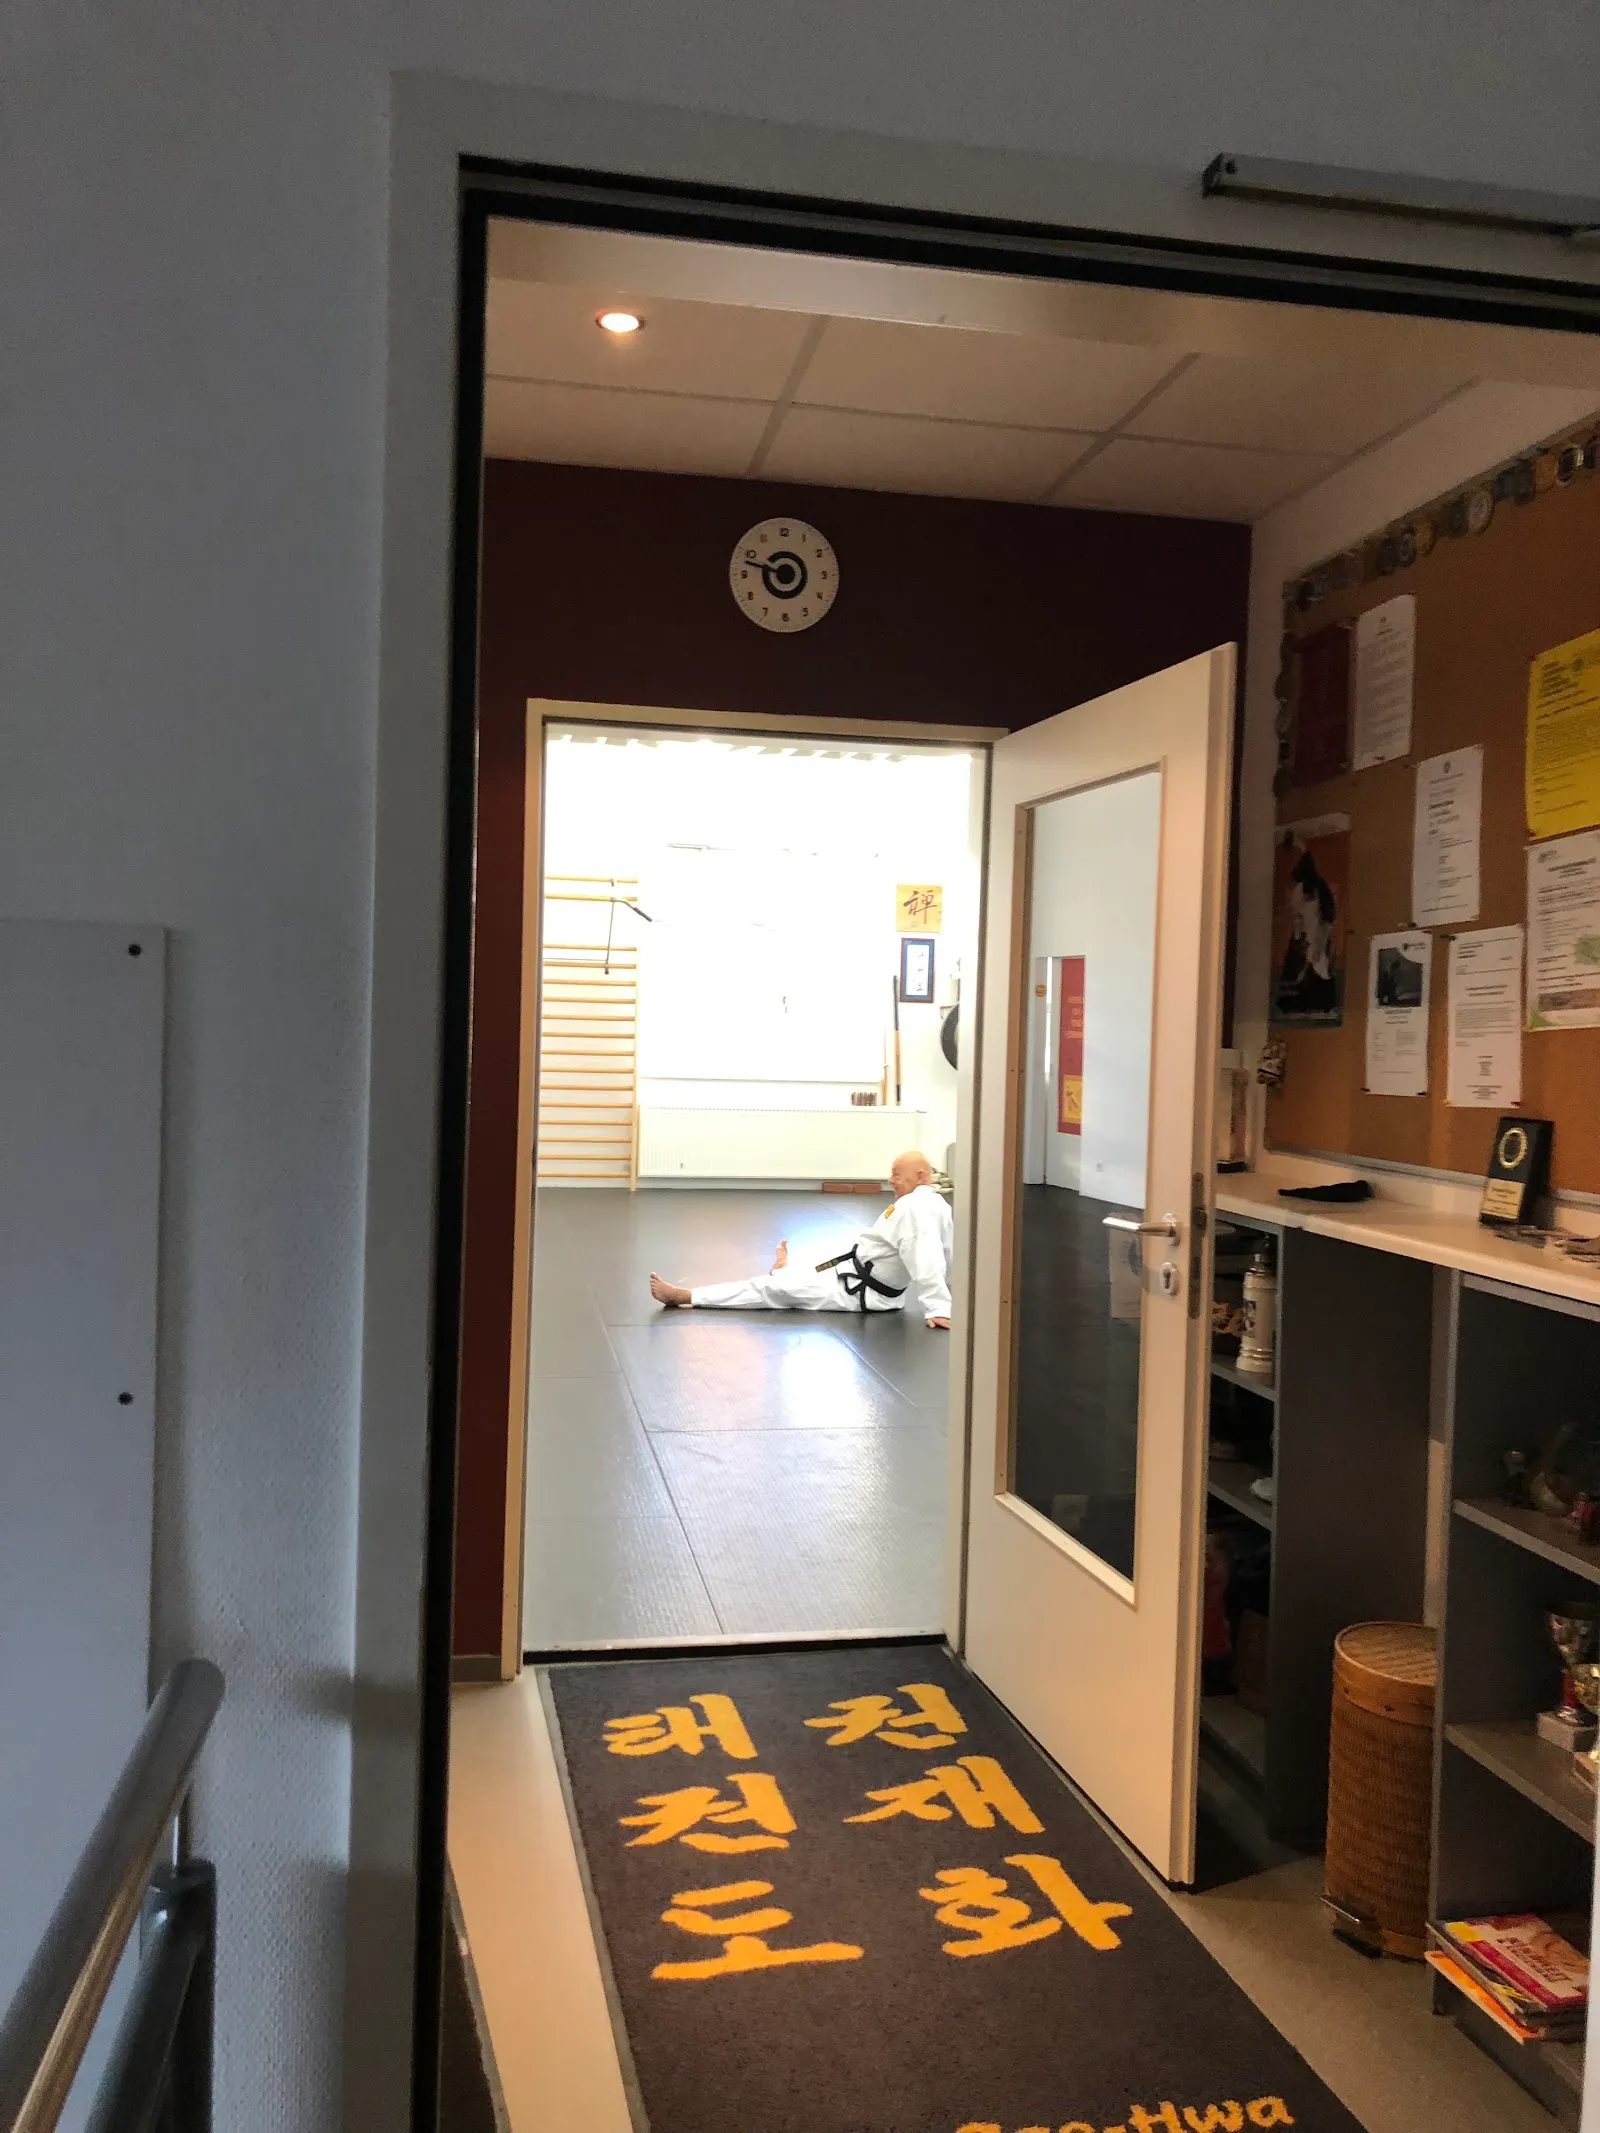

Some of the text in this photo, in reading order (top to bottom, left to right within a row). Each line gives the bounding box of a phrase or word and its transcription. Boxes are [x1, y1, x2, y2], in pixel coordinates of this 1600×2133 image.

[745, 549, 757, 559] 10
[815, 548, 823, 558] 2
[821, 570, 828, 580] 3
[762, 607, 769, 617] 7
[802, 607, 809, 617] 5
